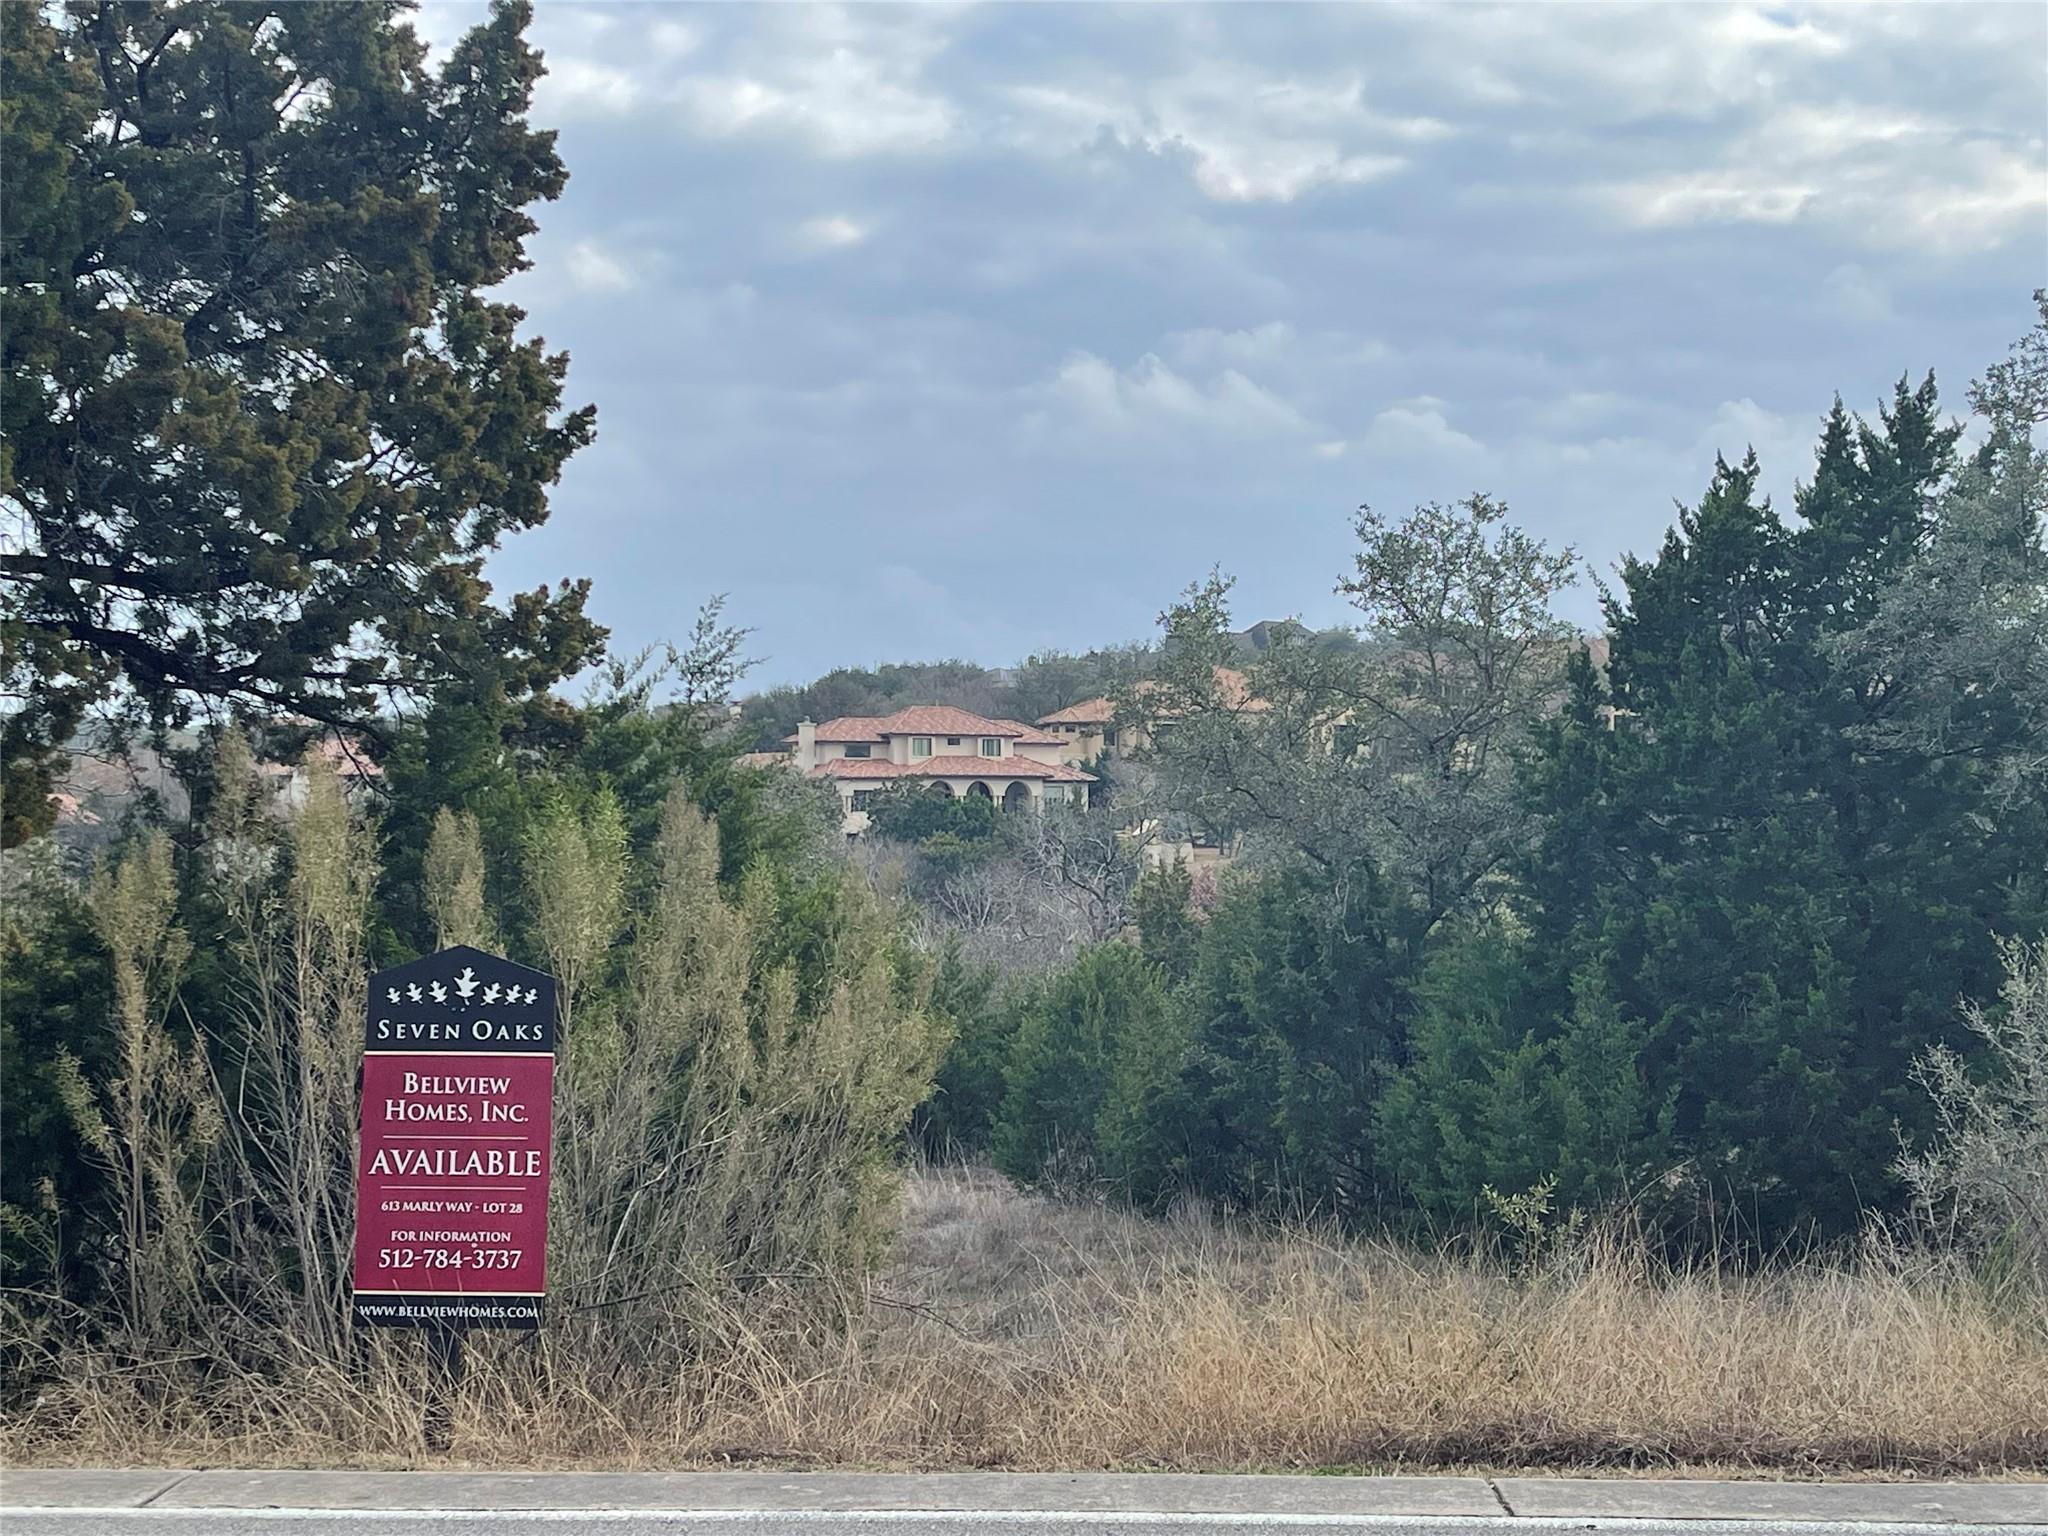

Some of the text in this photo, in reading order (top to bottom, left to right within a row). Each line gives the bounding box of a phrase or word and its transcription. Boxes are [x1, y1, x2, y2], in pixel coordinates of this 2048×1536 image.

[377, 1019, 543, 1041] SEVEN OAKS
[403, 1072, 511, 1094] BELLVIEW
[384, 1099, 529, 1124] HOMES, INC.
[368, 1149, 541, 1176] AVAILABLE
[381, 1200, 400, 1211] 613
[402, 1201, 443, 1212] MARLY
[446, 1202, 473, 1213] WAY
[482, 1203, 507, 1213] LOT
[508, 1203, 523, 1214] 28
[391, 1230, 511, 1242] FOR INFORMATION
[378, 1249, 522, 1269] 512-784-3737
[359, 1305, 538, 1318] WWW.BELLVIEWHOMES.COM
